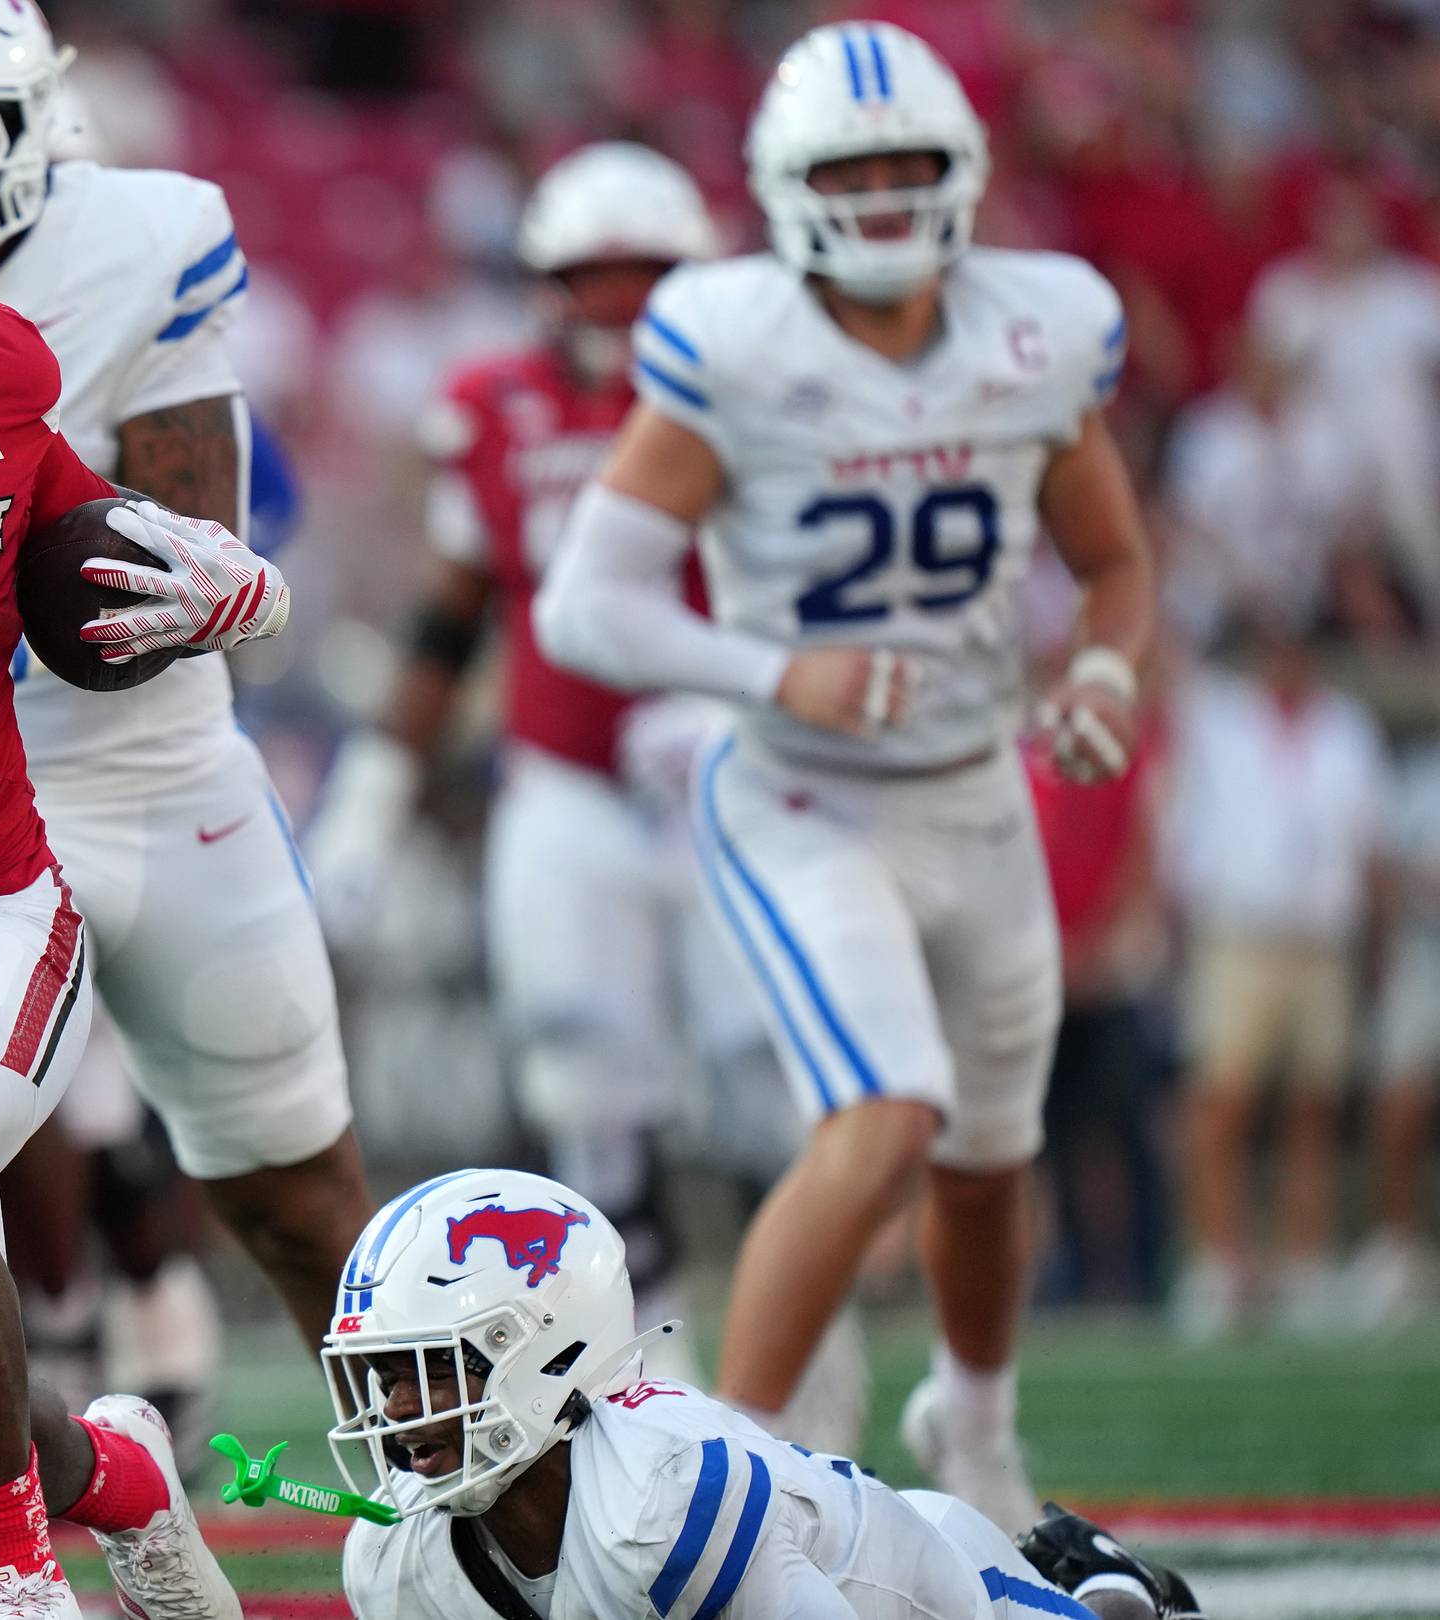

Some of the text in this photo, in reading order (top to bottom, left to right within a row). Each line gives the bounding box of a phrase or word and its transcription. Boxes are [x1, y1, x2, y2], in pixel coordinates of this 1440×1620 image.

[797, 484, 1001, 625] 29
[336, 1316, 364, 1334] ACC
[279, 1480, 340, 1512] NXTRND
